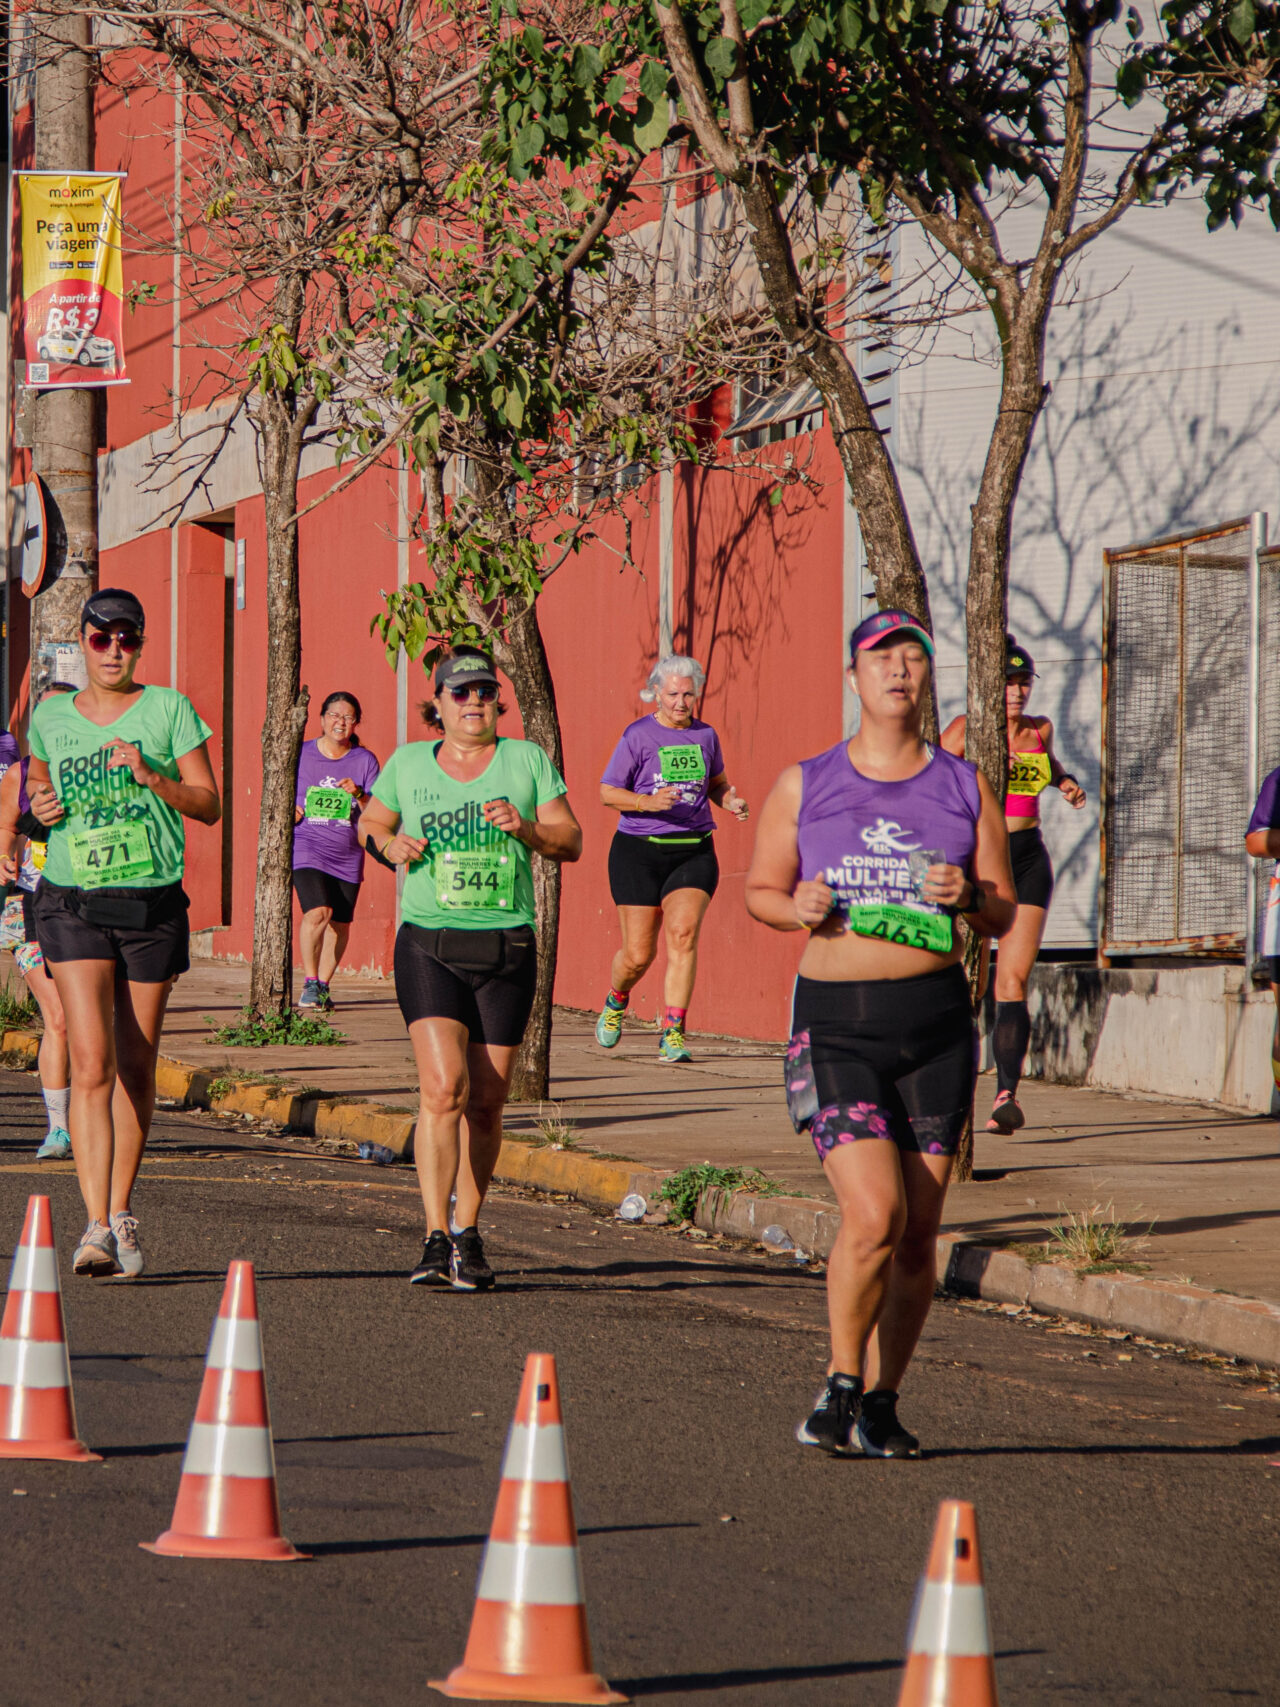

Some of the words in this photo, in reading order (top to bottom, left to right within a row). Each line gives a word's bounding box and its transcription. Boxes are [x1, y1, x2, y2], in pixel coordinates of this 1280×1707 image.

[49, 186, 95, 198] maxim
[36, 219, 73, 236] Peça
[76, 221, 108, 233] uma
[46, 236, 98, 253] viagem
[49, 293, 58, 305] A
[58, 293, 87, 305] partir
[88, 291, 102, 303] de
[670, 756, 699, 770] 495
[315, 797, 343, 810] 422
[86, 842, 130, 868] 471
[842, 856, 909, 869] CORRIDA
[452, 871, 500, 892] 544
[826, 867, 913, 889] MULHE
[871, 919, 930, 949] 465
